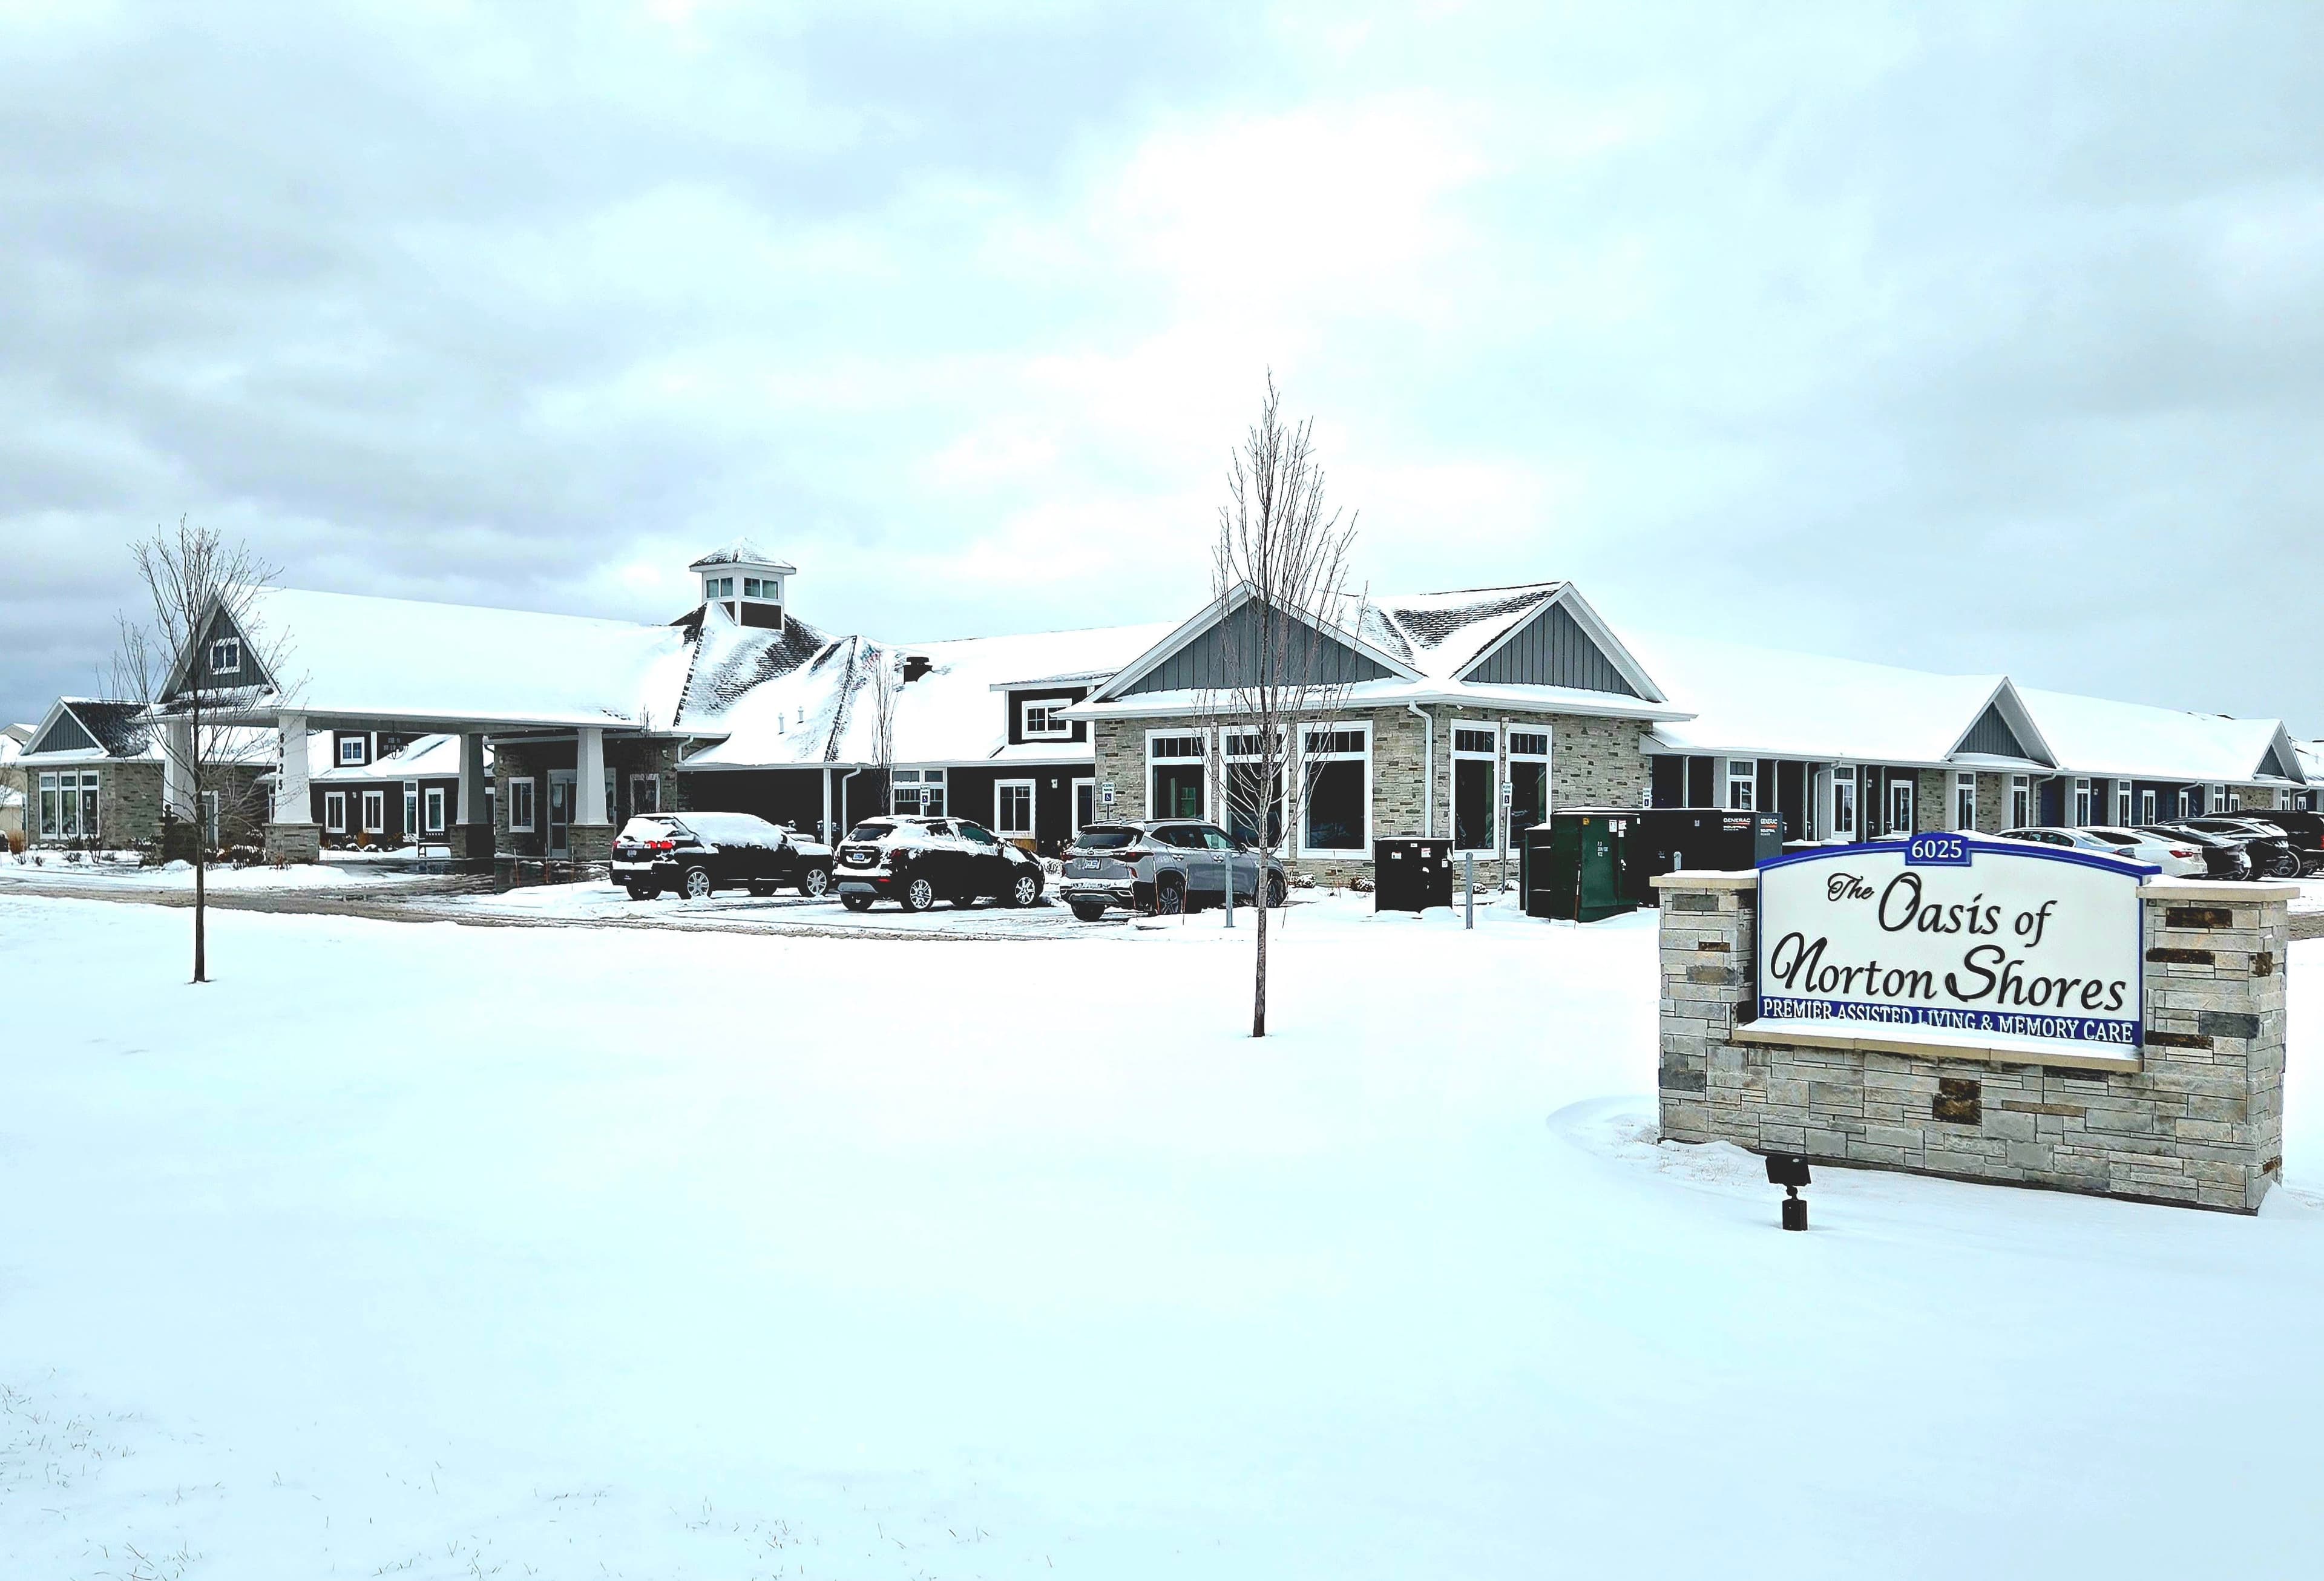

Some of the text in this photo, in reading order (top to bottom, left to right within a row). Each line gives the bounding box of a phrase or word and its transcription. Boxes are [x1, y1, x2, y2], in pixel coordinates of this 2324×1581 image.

[1911, 840, 1962, 859] 6025
[1827, 872, 2057, 948] The Oasis of
[1771, 932, 2126, 1011] Norton Shores
[1762, 998, 2133, 1043] PREMIER ASSISTED LIVING & MEMORY CARE
